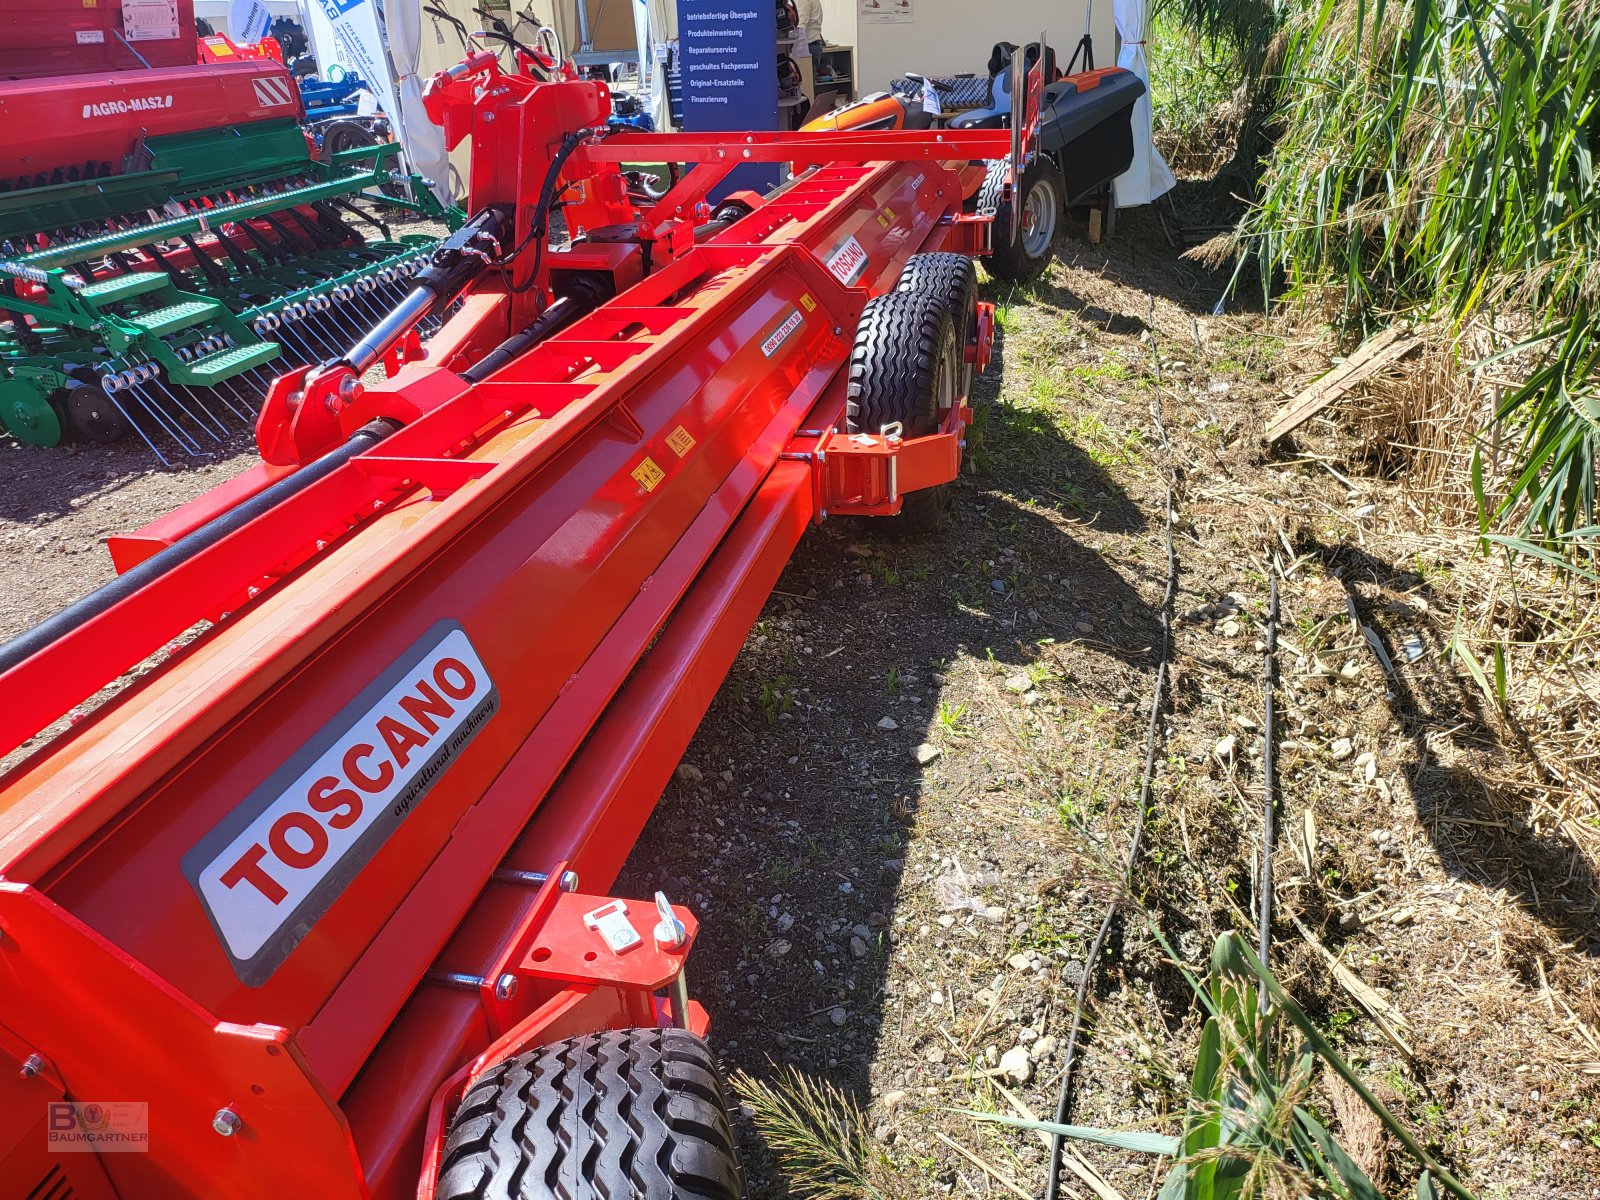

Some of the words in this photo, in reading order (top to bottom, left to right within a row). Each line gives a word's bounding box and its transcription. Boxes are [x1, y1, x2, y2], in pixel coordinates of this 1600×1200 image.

[686, 12, 729, 20] betriebsfertige
[729, 10, 758, 20] Übergabe
[687, 29, 743, 37] Produkteinweisung
[688, 46, 737, 55] Reparaturservice
[689, 63, 720, 72] geschultes
[720, 61, 759, 70] Fachpersonal
[690, 79, 745, 88] Original-Ersatzteile
[691, 96, 728, 104] Finanzierung
[92, 96, 165, 117] AGRO-MASZ
[831, 242, 864, 280] TOSCANO
[394, 744, 452, 817] agricultural
[450, 700, 495, 758] machinery
[219, 657, 477, 906] TOSCANO
